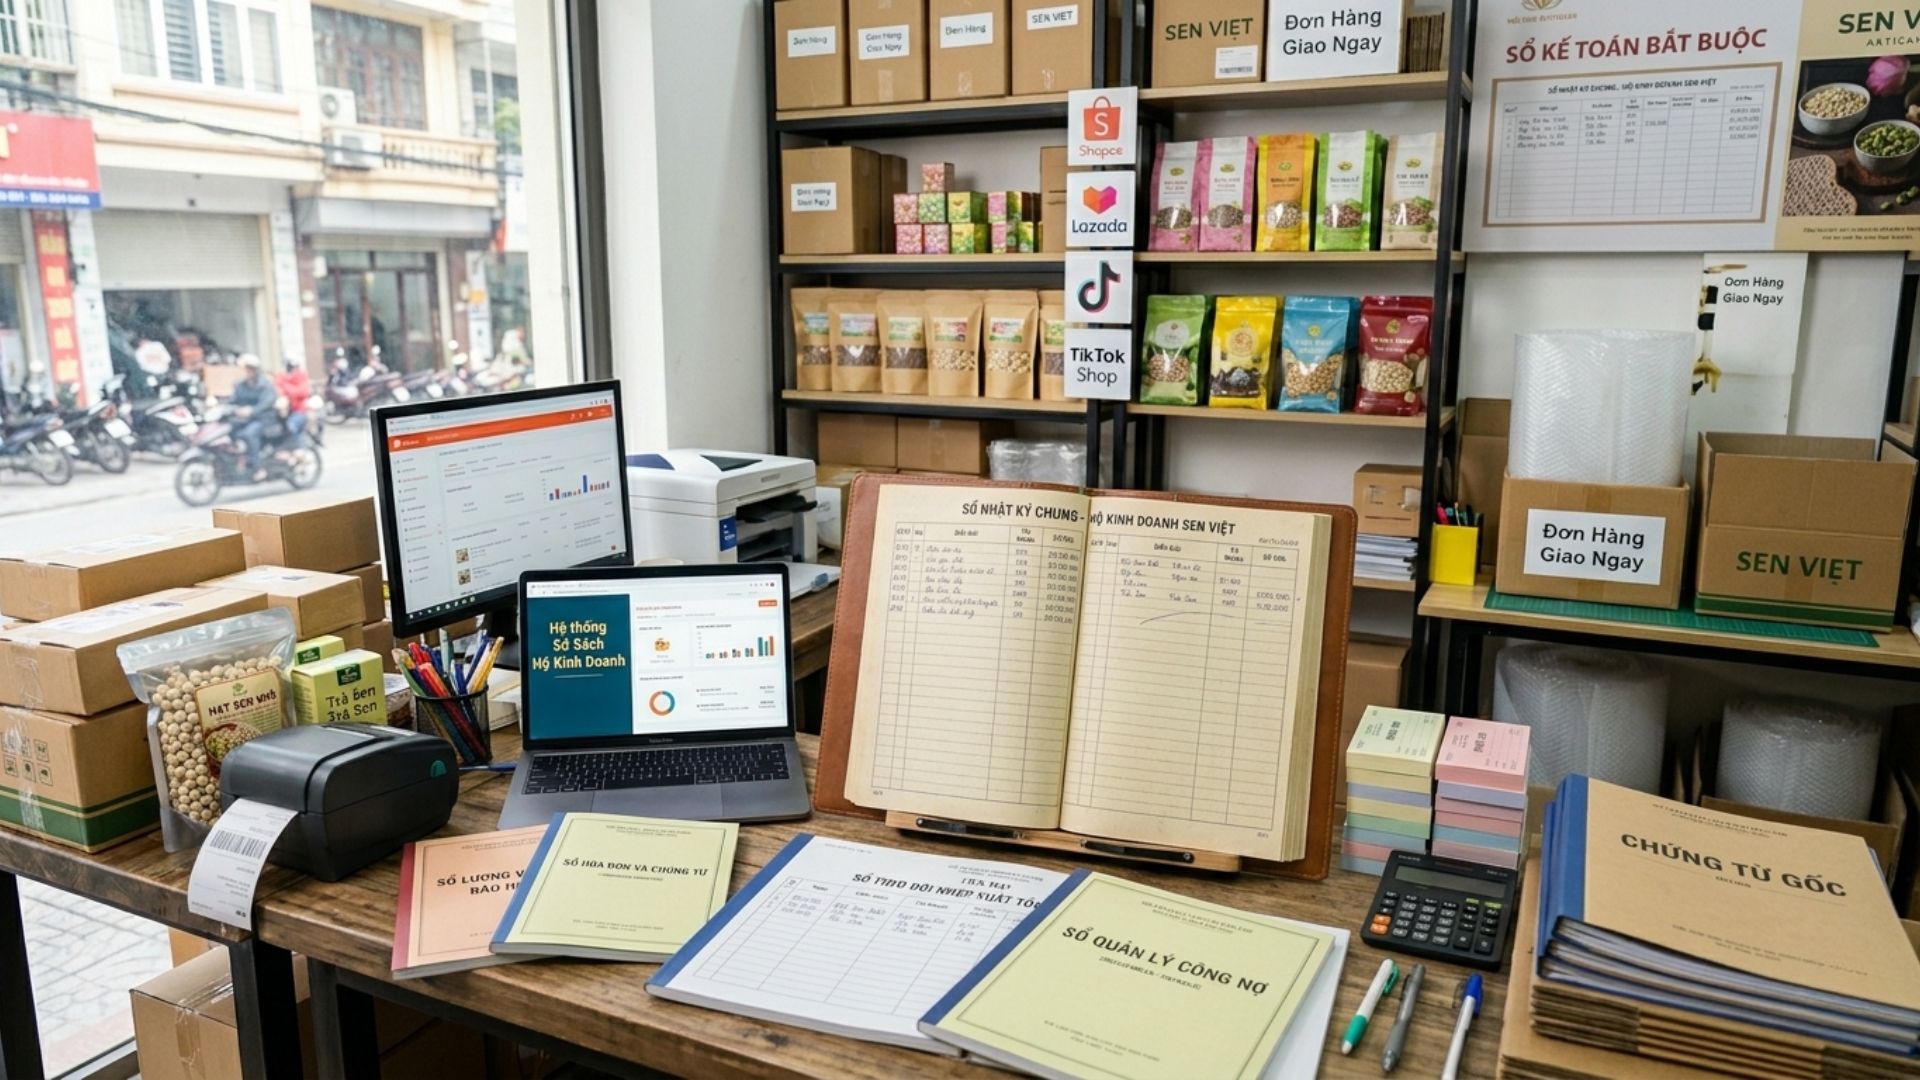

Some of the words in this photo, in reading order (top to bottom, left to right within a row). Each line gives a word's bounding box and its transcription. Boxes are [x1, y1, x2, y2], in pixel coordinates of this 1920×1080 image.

[1284, 14, 1325, 31] Đơn
[1331, 7, 1382, 28] Hàng
[1838, 10, 1895, 34] SEN
[1165, 22, 1202, 41] SEN
[1282, 37, 1327, 56] Giao
[1332, 35, 1383, 55] Ngay
[1541, 35, 1572, 61] KẾ
[1575, 34, 1640, 60] TOÁN
[1646, 28, 1692, 55] BẮT
[1697, 26, 1768, 55] BUỘC
[1072, 218, 1128, 235] Lazada
[1753, 276, 1784, 290] Hàng
[1723, 292, 1750, 304] Giao
[1753, 292, 1784, 306] Ngay
[1070, 347, 1126, 364] TikTok
[1076, 367, 1118, 387] Shop
[1106, 513, 1134, 526] KINH
[1137, 515, 1179, 530] DOANH
[1181, 519, 1206, 532] SEN
[1208, 520, 1236, 537] VIỆT
[1542, 523, 1585, 542] Đơn
[1591, 526, 1645, 550] Hàng
[1540, 546, 1586, 567] Giao
[1591, 550, 1645, 573] Ngay
[1736, 550, 1790, 576] SEN
[570, 619, 607, 636] thống
[553, 655, 582, 669] Kinh
[585, 653, 626, 668] Doanh
[1621, 833, 1723, 873] CHỨNG
[1781, 873, 1847, 898] GỐC
[1237, 976, 1270, 997] NỢ
